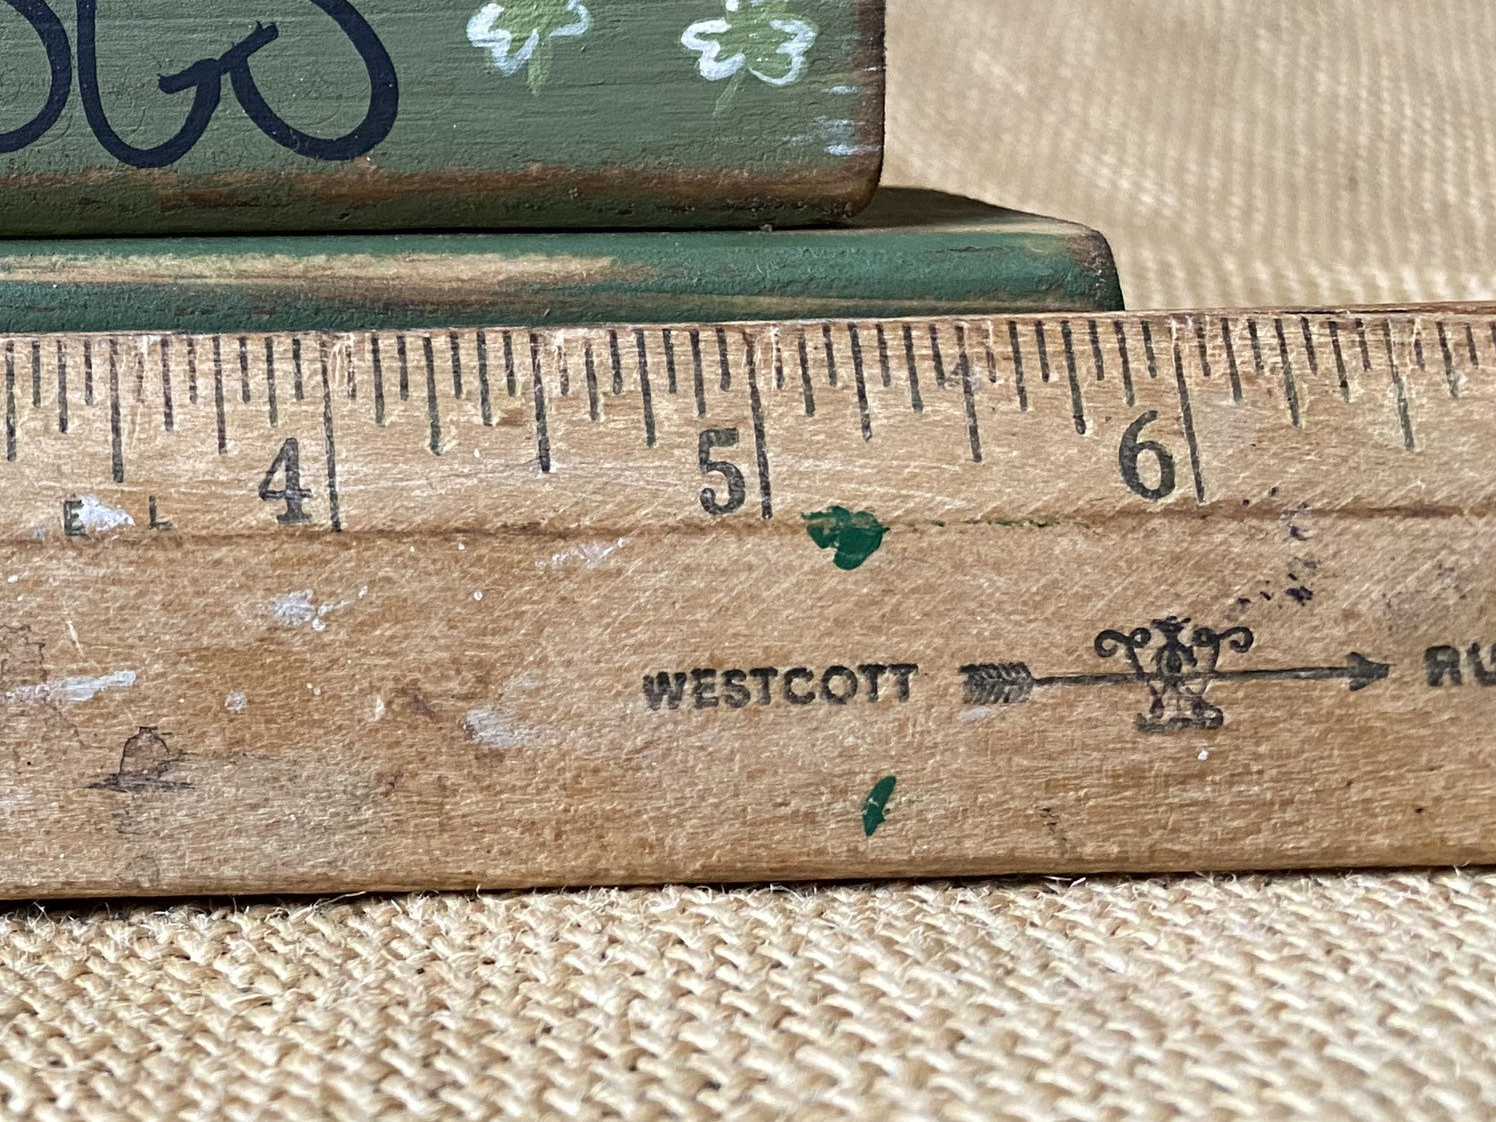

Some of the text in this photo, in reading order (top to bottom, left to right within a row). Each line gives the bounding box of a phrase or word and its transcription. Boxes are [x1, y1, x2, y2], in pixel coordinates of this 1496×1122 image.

[258, 437, 312, 524] 4
[698, 427, 747, 518] 5
[1119, 410, 1175, 501] 6
[642, 663, 919, 711] WESTCOTT
